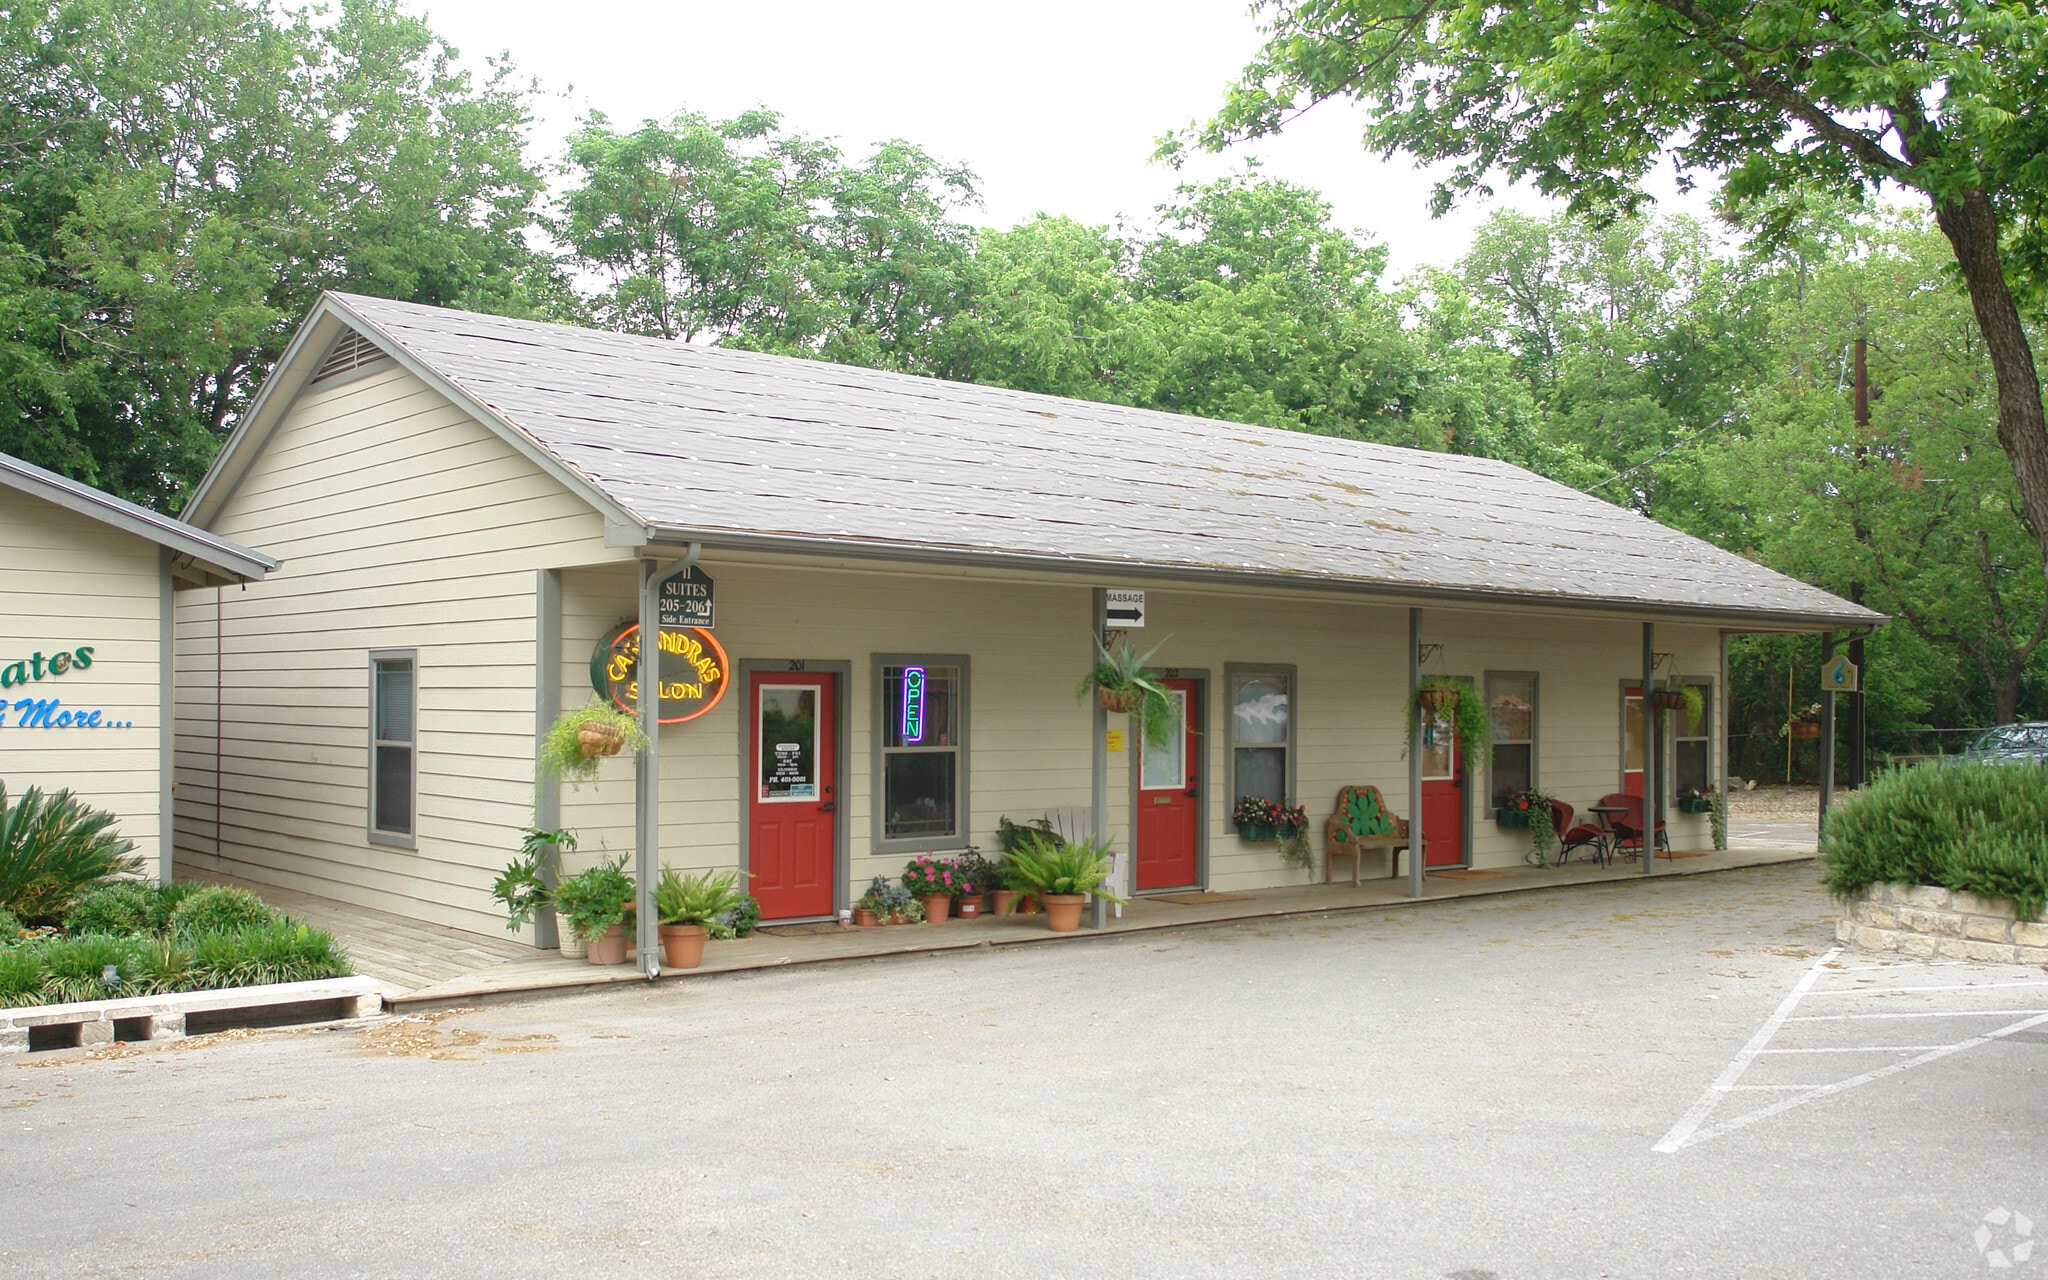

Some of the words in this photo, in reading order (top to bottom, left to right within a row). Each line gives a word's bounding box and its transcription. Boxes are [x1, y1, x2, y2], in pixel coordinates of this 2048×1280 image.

[665, 582, 707, 597] SUITES
[1106, 593, 1144, 603] MASSAGE
[660, 598, 705, 613] 205-206
[661, 614, 677, 624] Side
[679, 615, 710, 625] Entrance
[607, 630, 721, 683] CANDRA'S
[0, 646, 95, 689] ates
[627, 680, 703, 700] SLON
[906, 671, 921, 736] OPEN
